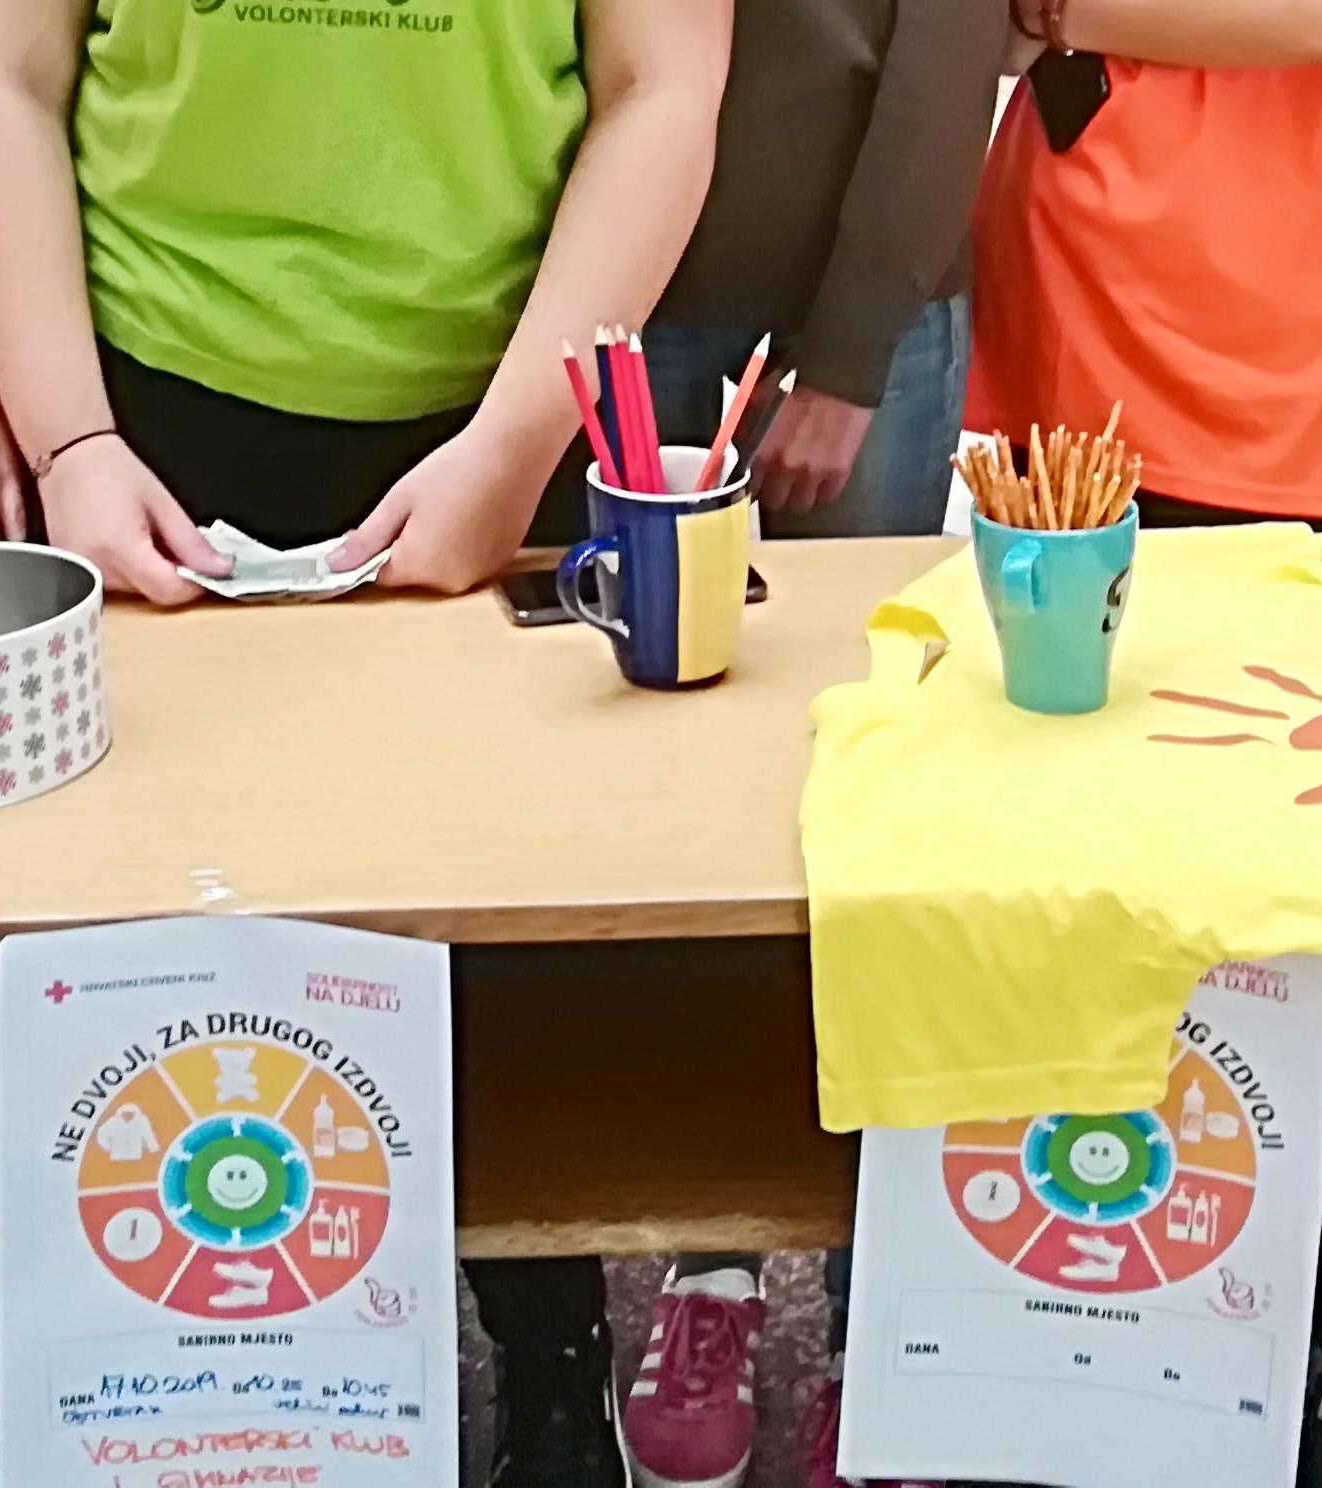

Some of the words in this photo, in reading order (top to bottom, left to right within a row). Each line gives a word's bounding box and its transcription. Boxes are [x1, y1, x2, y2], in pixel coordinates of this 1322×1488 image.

[234, 3, 391, 29] VOLONTERSKI
[398, 12, 454, 33] KLUB
[306, 985, 334, 1002] NA
[51, 1123, 86, 1163] NE
[156, 1015, 200, 1050] ZA
[207, 1012, 333, 1062] DRUGOG
[334, 1057, 413, 1159] IZDVOJI
[1209, 1041, 1284, 1149] IZDVOJI
[81, 1427, 313, 1465] VOLONTERSKI
[330, 1430, 410, 1458] KLUB
